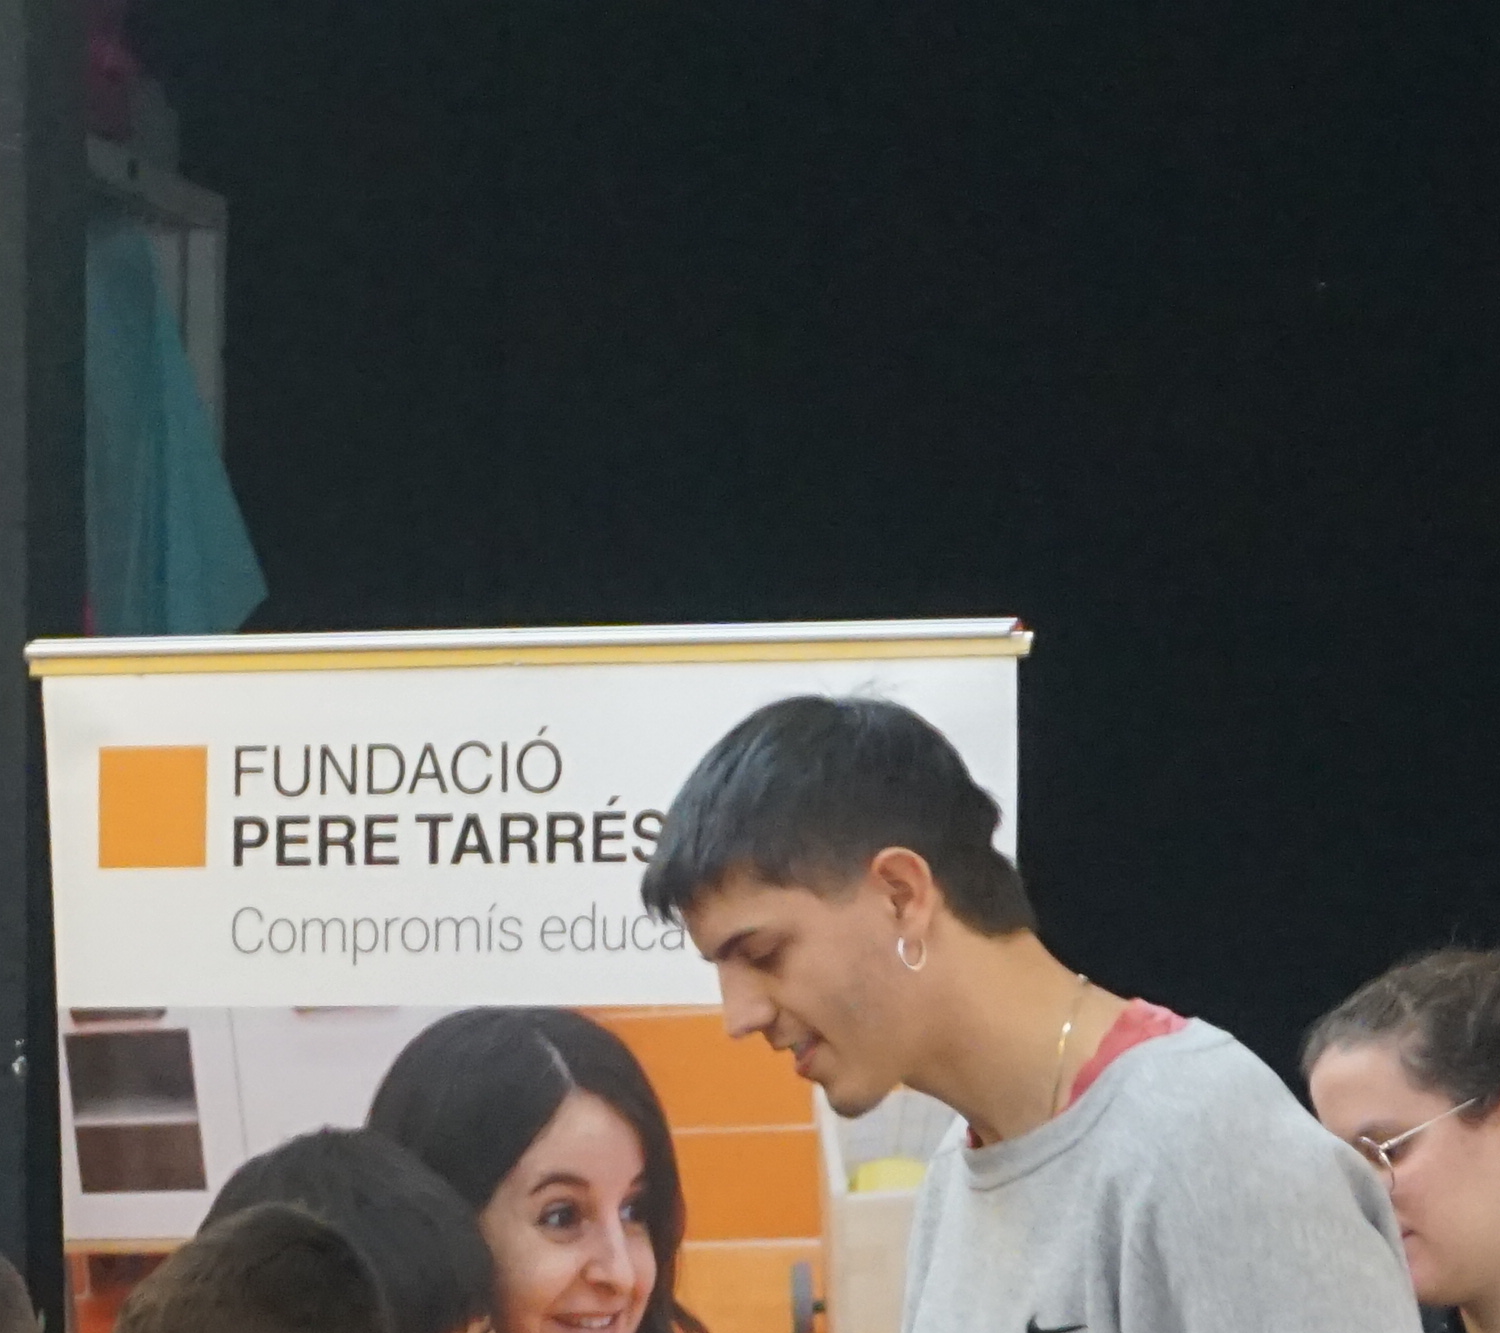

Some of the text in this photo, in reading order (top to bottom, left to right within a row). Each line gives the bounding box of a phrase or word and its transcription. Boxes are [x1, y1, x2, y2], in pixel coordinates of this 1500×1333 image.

[234, 725, 563, 797] FUNDACIÓ
[233, 795, 668, 867] PERE TARRÉS
[231, 901, 686, 966] Compromís educa
